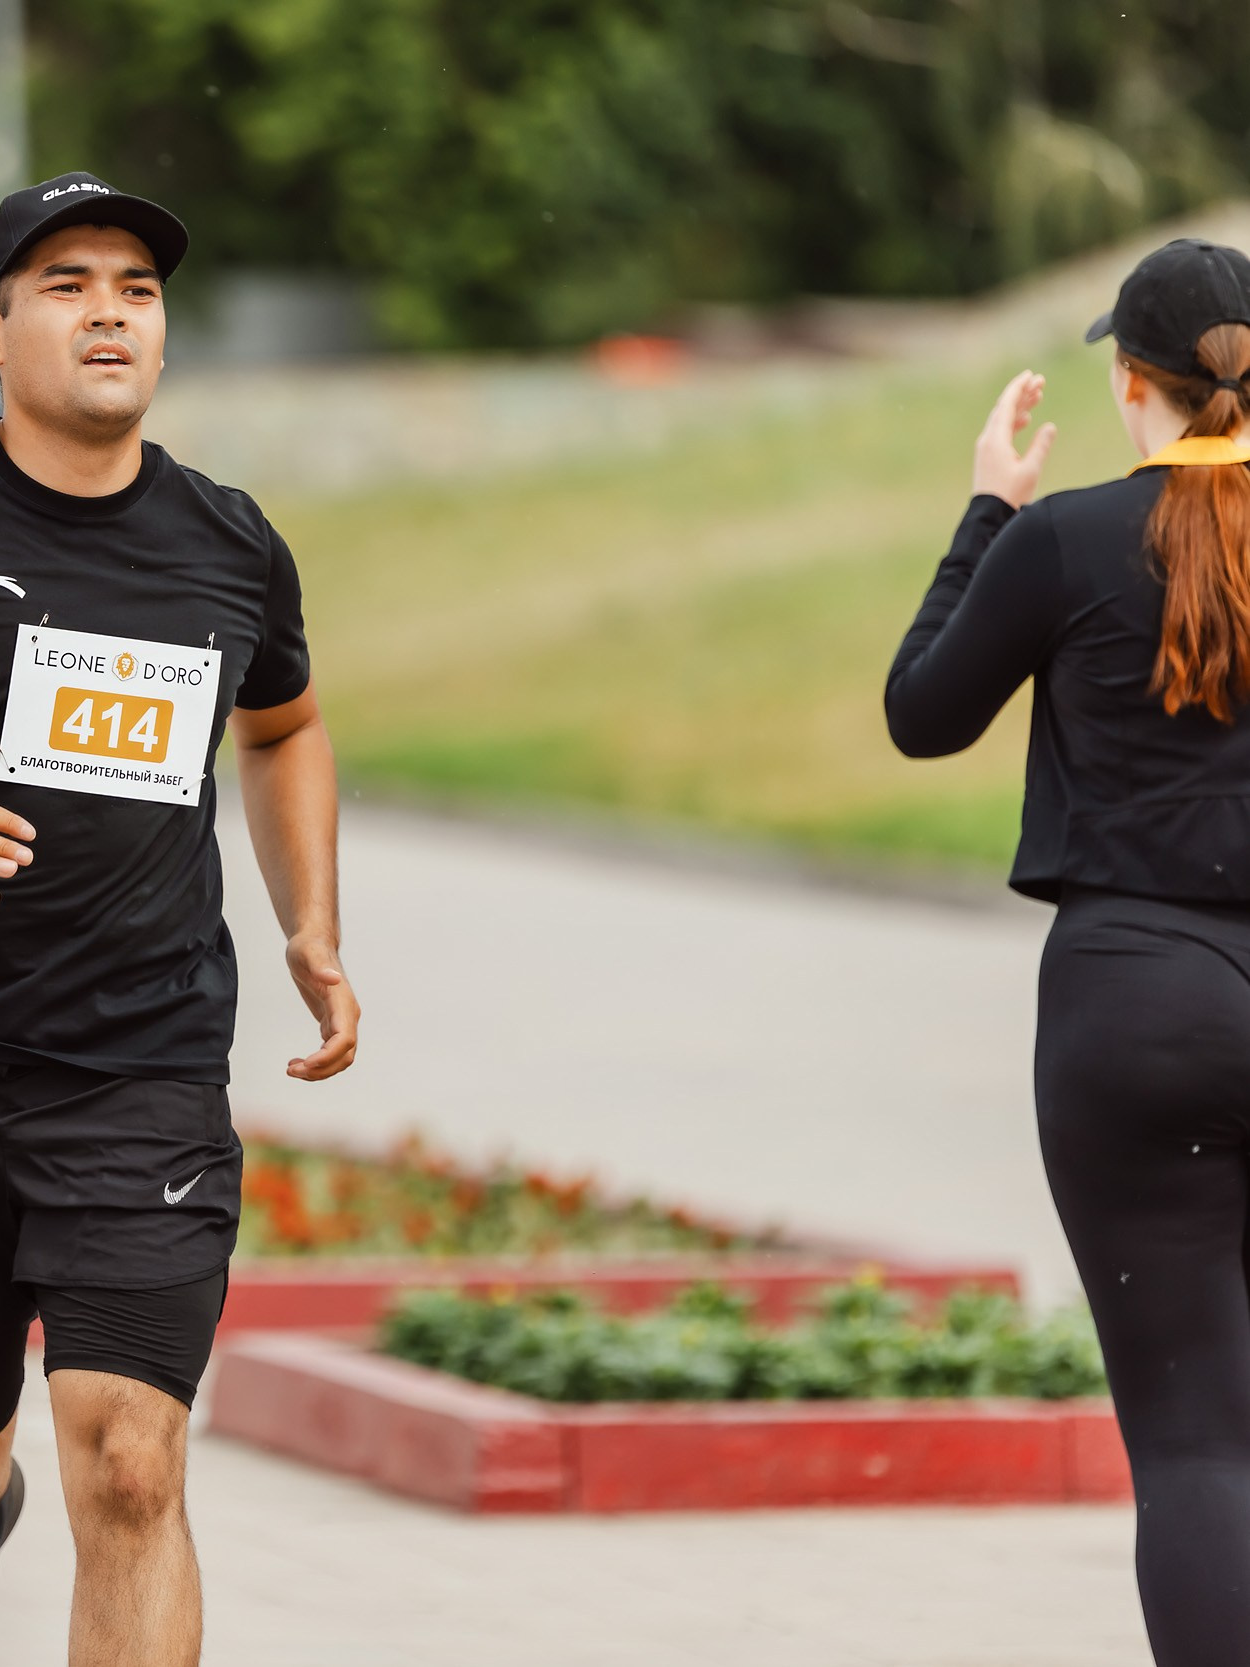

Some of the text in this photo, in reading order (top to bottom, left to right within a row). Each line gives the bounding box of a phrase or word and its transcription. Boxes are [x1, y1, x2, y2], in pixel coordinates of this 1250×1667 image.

[42, 183, 115, 202] GLASM
[34, 648, 203, 686] LEONE D'ORO
[62, 697, 158, 753] 414
[20, 755, 184, 786] БЛАГОТВОРИТЕЛЬНЫЙ ЗАБЕГ
